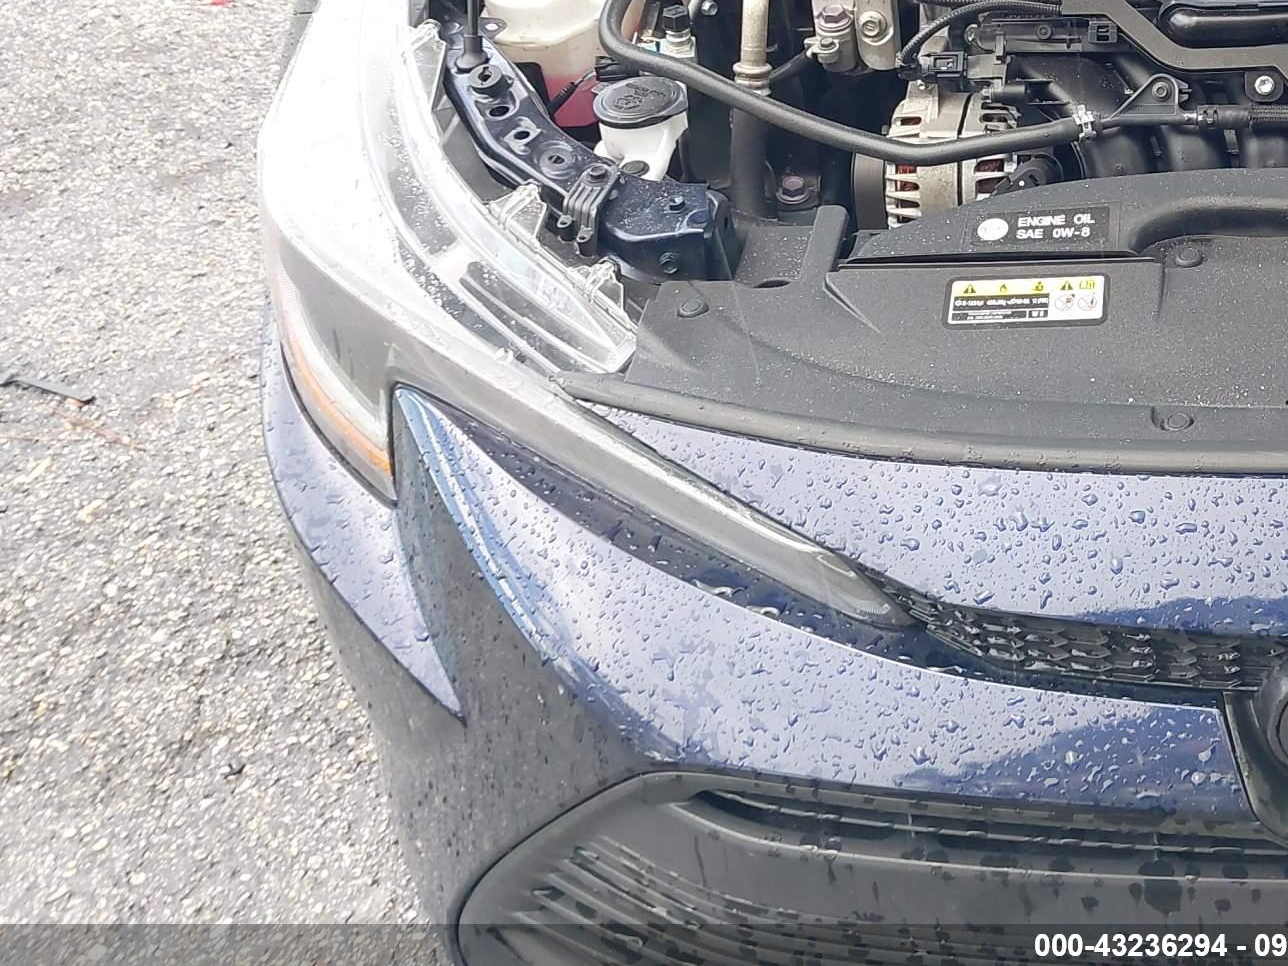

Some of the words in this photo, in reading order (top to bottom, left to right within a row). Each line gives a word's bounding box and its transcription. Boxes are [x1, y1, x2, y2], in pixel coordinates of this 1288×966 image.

[1017, 214, 1066, 227] ENGINE
[1073, 213, 1095, 225] OIL
[1016, 228, 1044, 239] SAE
[1052, 226, 1090, 238] 0W-8
